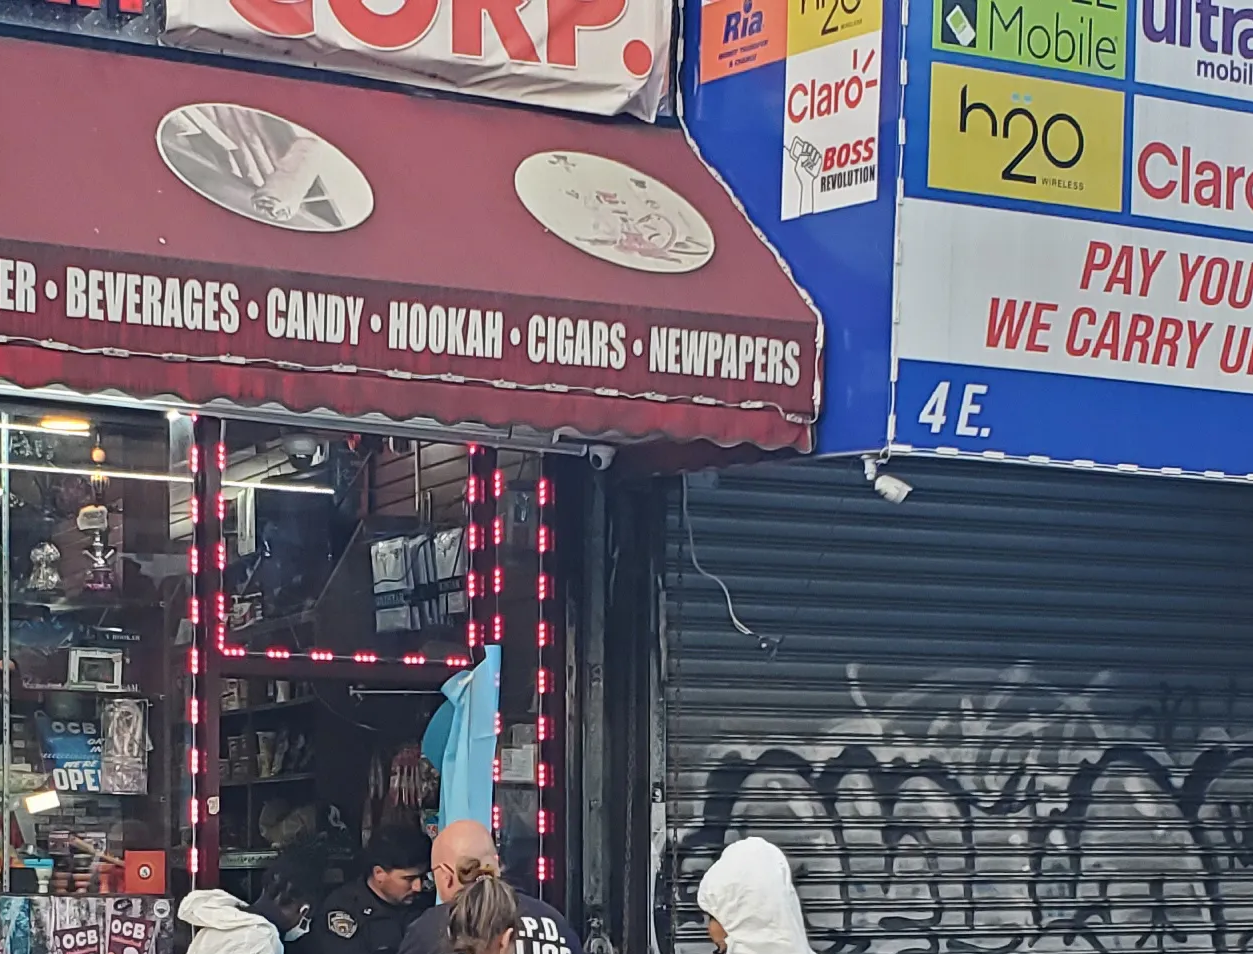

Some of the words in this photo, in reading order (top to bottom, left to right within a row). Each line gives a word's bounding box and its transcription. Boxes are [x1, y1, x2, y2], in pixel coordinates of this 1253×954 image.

[723, 0, 764, 44] Ria
[989, 0, 1117, 70] Mobile
[787, 75, 863, 123] Claro
[822, 137, 875, 172] BOSS
[1137, 141, 1253, 211] Clar
[820, 164, 876, 193] REVOLUTION
[1041, 177, 1084, 191] WIRELESS
[1079, 240, 1166, 298] PAY
[66, 266, 240, 335] BEVERAGES
[266, 287, 364, 346] CANDY
[388, 301, 504, 359] HOOKAH
[527, 314, 627, 370] CIGARS
[649, 326, 801, 388] NEWPAPERS
[985, 297, 1059, 353] WE
[1065, 307, 1214, 369] CARRY
[1219, 324, 1253, 376] U
[918, 381, 951, 434] 4
[955, 383, 991, 438] E.
[51, 720, 96, 735] OCB
[52, 768, 102, 792] OPE
[62, 929, 98, 949] OCB
[111, 919, 146, 940] OCB
